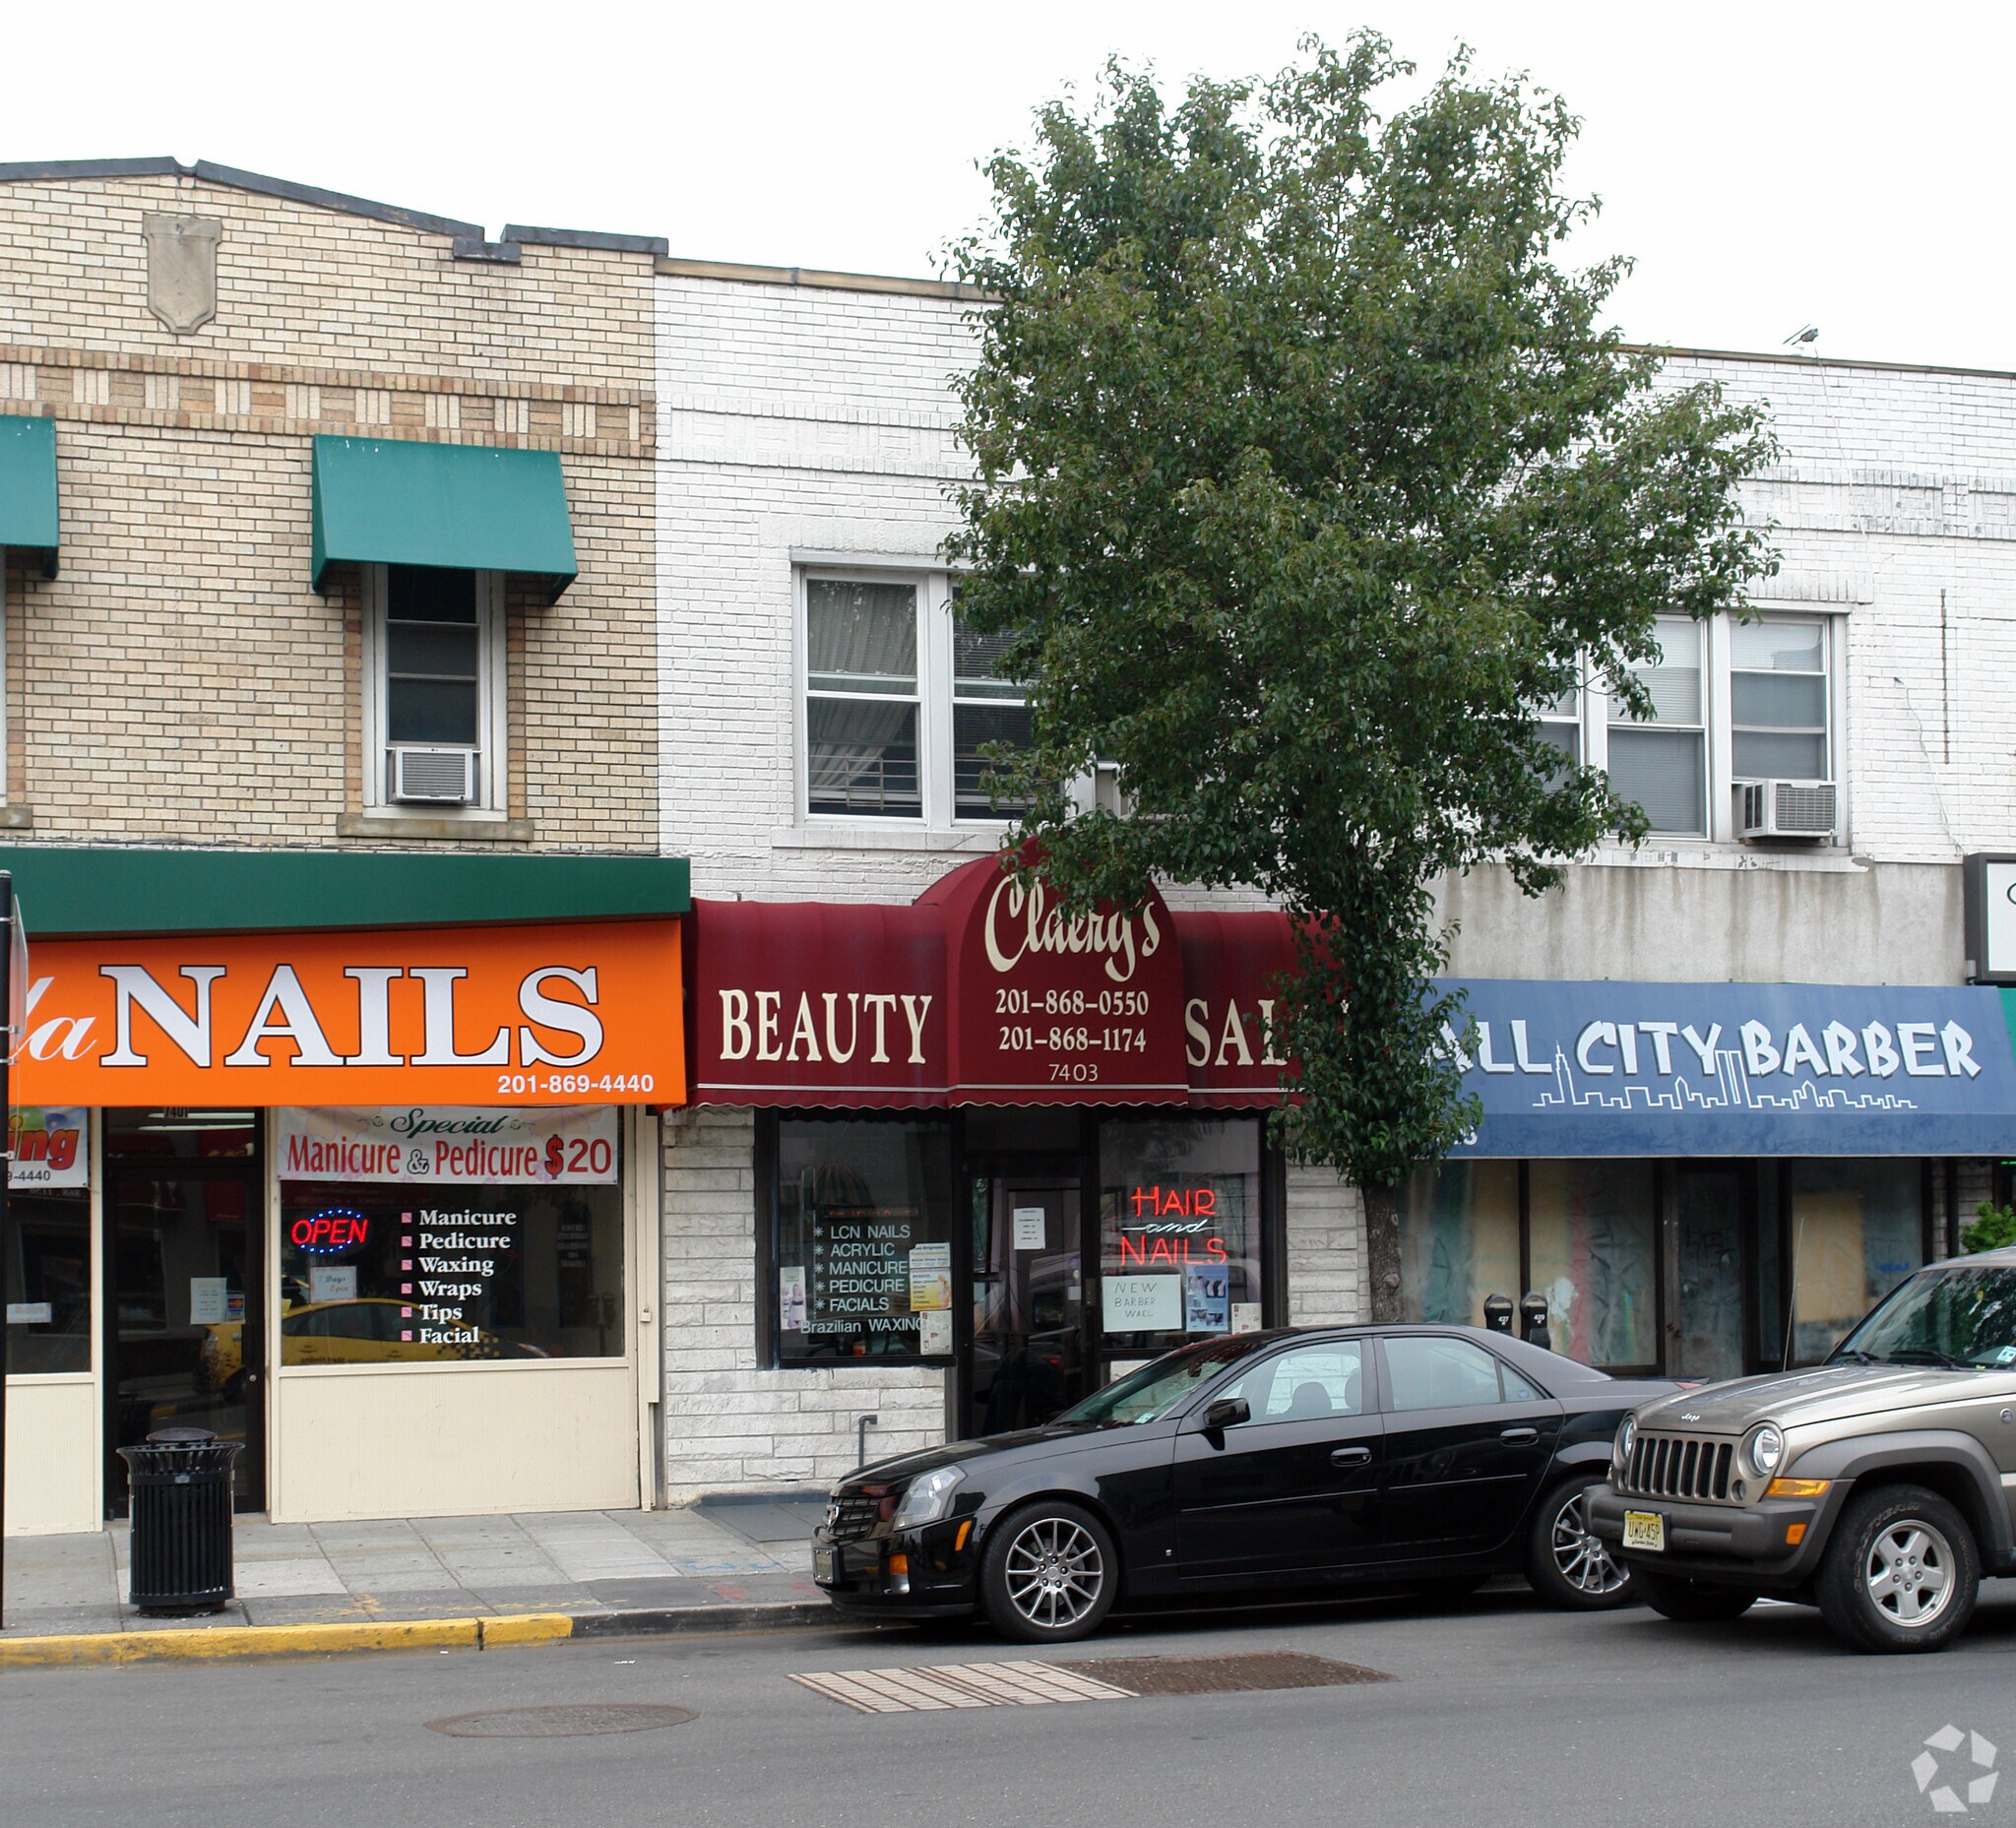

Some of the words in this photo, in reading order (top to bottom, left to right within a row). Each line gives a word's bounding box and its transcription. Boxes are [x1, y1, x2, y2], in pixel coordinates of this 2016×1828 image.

[994, 988, 1150, 1016] 201-868-0550
[98, 964, 604, 1069] NAILS
[719, 988, 933, 1065] BEAUTY
[1184, 997, 1354, 1068] SAL
[998, 1026, 1148, 1053] 201-868-1174
[1575, 1019, 1724, 1076] CITY
[1738, 1018, 1983, 1081] BARBER
[1047, 1063, 1100, 1082] 7403
[497, 1074, 655, 1094] 201-869-4440
[390, 1107, 509, 1139] Special
[286, 1134, 402, 1174] Manicure
[406, 1148, 430, 1175] &
[435, 1138, 538, 1177] Pedicure
[544, 1134, 612, 1179] $20
[1130, 1184, 1217, 1218] HAIR
[418, 1209, 518, 1227] Manicure
[1128, 1218, 1218, 1233] and
[290, 1218, 369, 1245] OPEN
[418, 1231, 512, 1249] Pedicure
[830, 1226, 860, 1240] LCN
[867, 1224, 912, 1239] NAILS
[830, 1242, 896, 1258] ACRYLIC
[1119, 1233, 1228, 1267] NAILS
[417, 1256, 495, 1278] Waxing
[829, 1260, 909, 1276] MANICURE
[417, 1280, 482, 1300] Wraps
[829, 1279, 906, 1293] PEDICURE
[1114, 1282, 1158, 1294] NEW
[829, 1297, 890, 1312] FACIALS
[1114, 1296, 1157, 1308] BARBER
[418, 1303, 464, 1325] Tips
[418, 1326, 481, 1345] Facial
[800, 1319, 862, 1335] Brazilian
